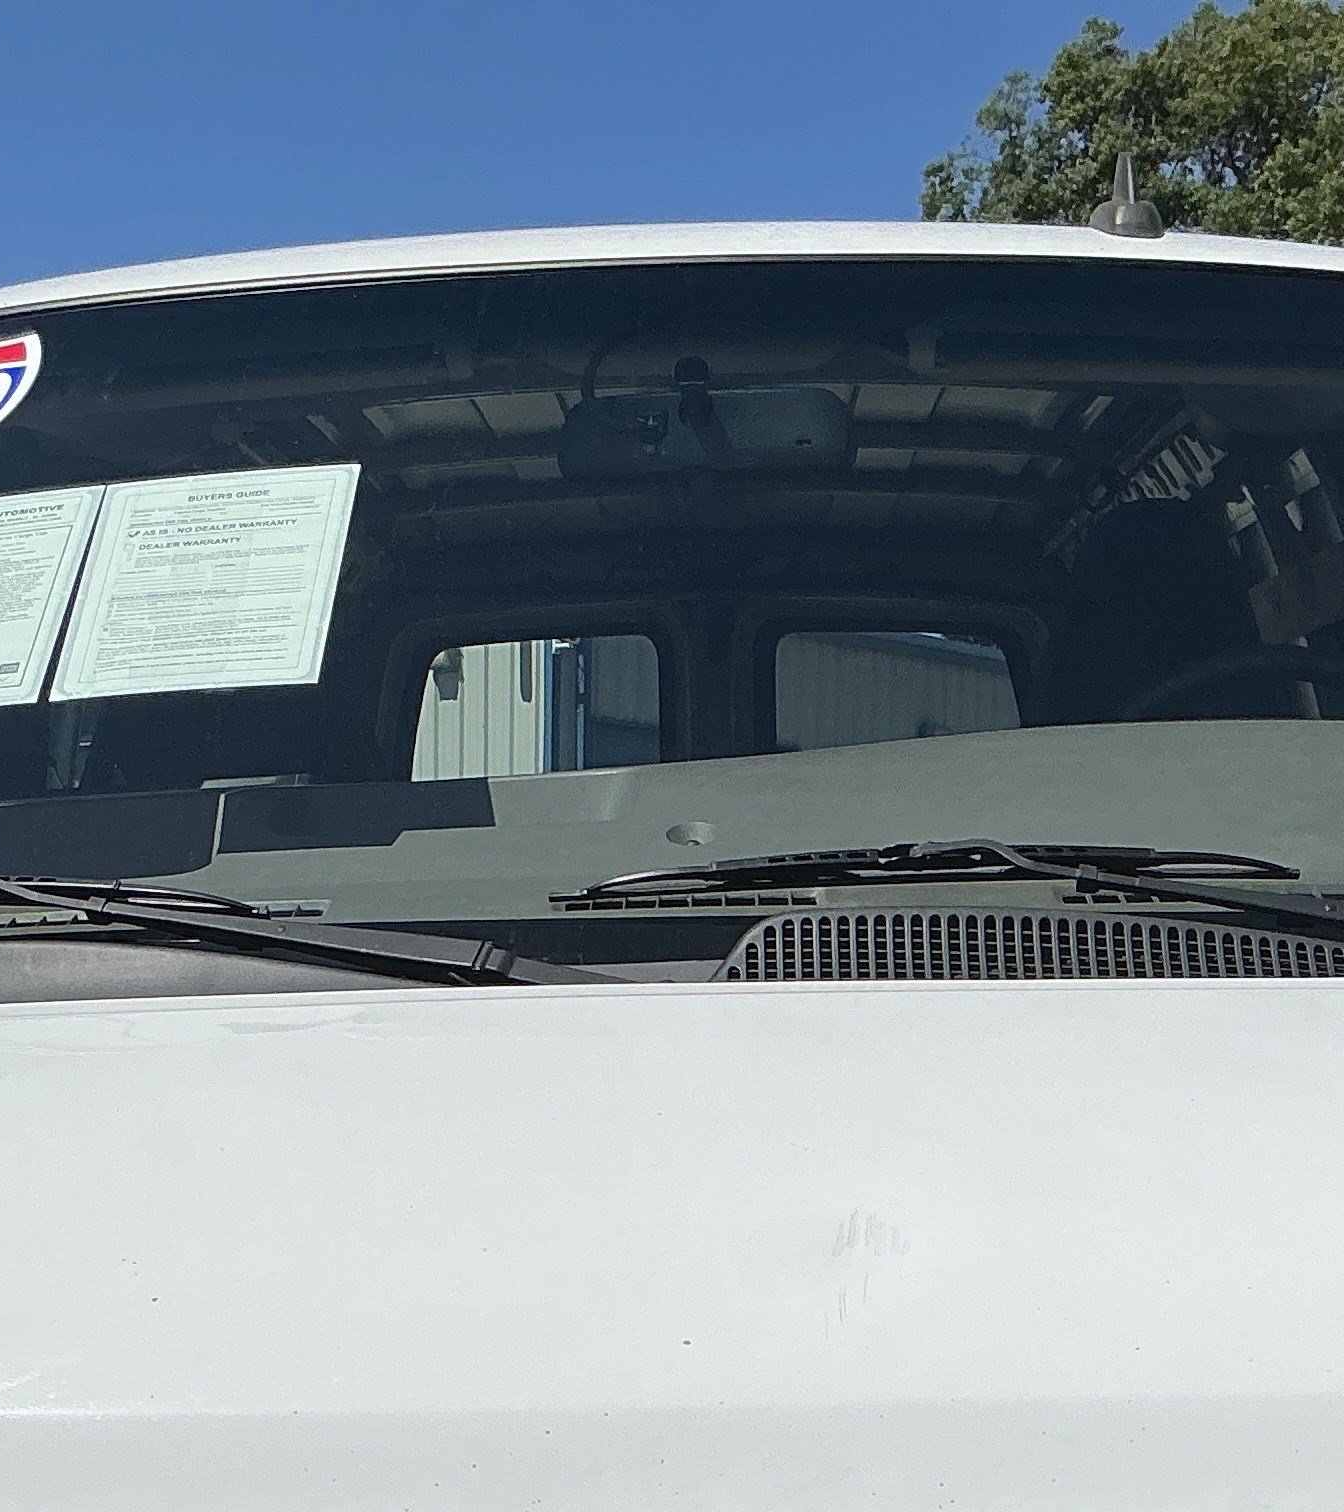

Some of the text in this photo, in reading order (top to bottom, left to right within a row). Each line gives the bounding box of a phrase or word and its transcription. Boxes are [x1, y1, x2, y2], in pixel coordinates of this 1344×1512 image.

[188, 491, 233, 502] BUYERS
[177, 525, 193, 534] NO
[195, 522, 237, 532] DEALER
[238, 517, 298, 530] WARRANTY
[138, 536, 242, 551] DEALER WARRANTY
